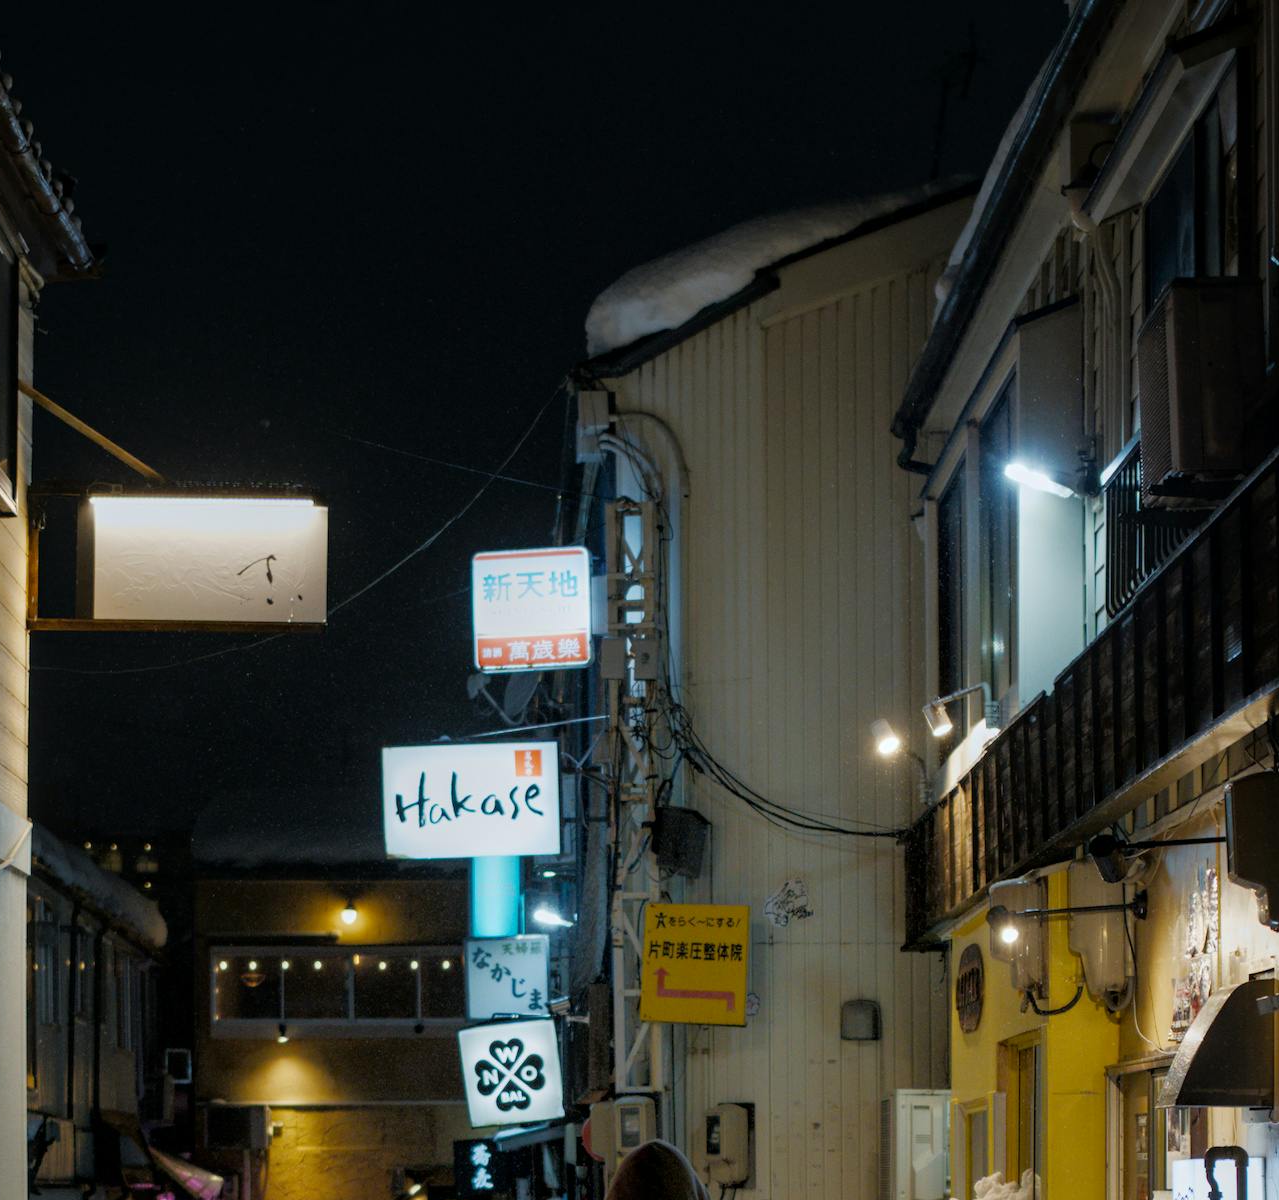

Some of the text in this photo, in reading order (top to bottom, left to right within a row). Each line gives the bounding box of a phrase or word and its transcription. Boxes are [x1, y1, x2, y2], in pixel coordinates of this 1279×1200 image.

[483, 569, 578, 602] 新天地
[395, 771, 544, 828] Hakase
[649, 940, 742, 961] 片町楽圧整体院
[472, 947, 543, 1010] なかじま
